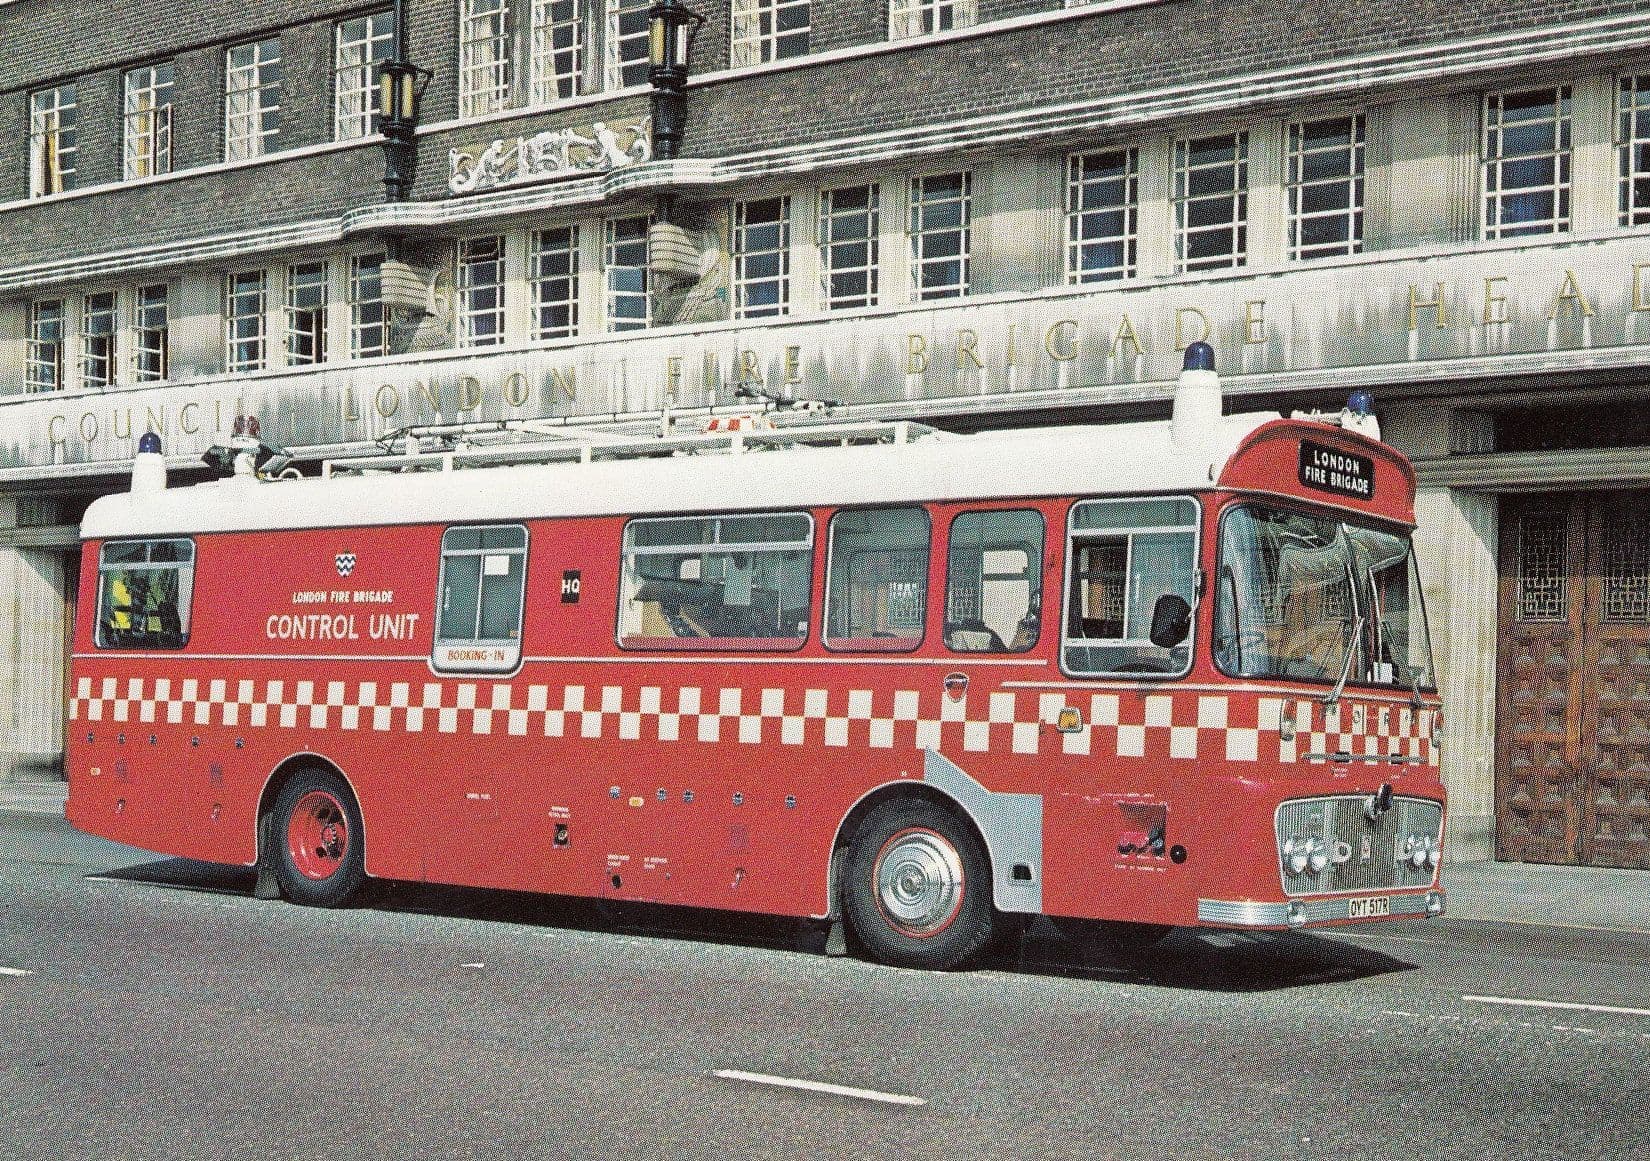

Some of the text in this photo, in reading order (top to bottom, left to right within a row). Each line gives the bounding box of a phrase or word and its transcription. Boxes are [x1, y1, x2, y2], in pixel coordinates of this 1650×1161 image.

[345, 366, 577, 421] LONDON
[667, 345, 802, 395] FIRE
[905, 300, 1269, 375] BRIGADE
[1314, 450, 1360, 475] LONDON
[1305, 466, 1369, 494] FIRE BRIGADE
[293, 590, 393, 604] LONDON FIRE BRIGADE
[561, 578, 580, 594] HQ
[266, 613, 420, 640] CONTROL UNIT
[1350, 897, 1388, 916] OYT 517R
